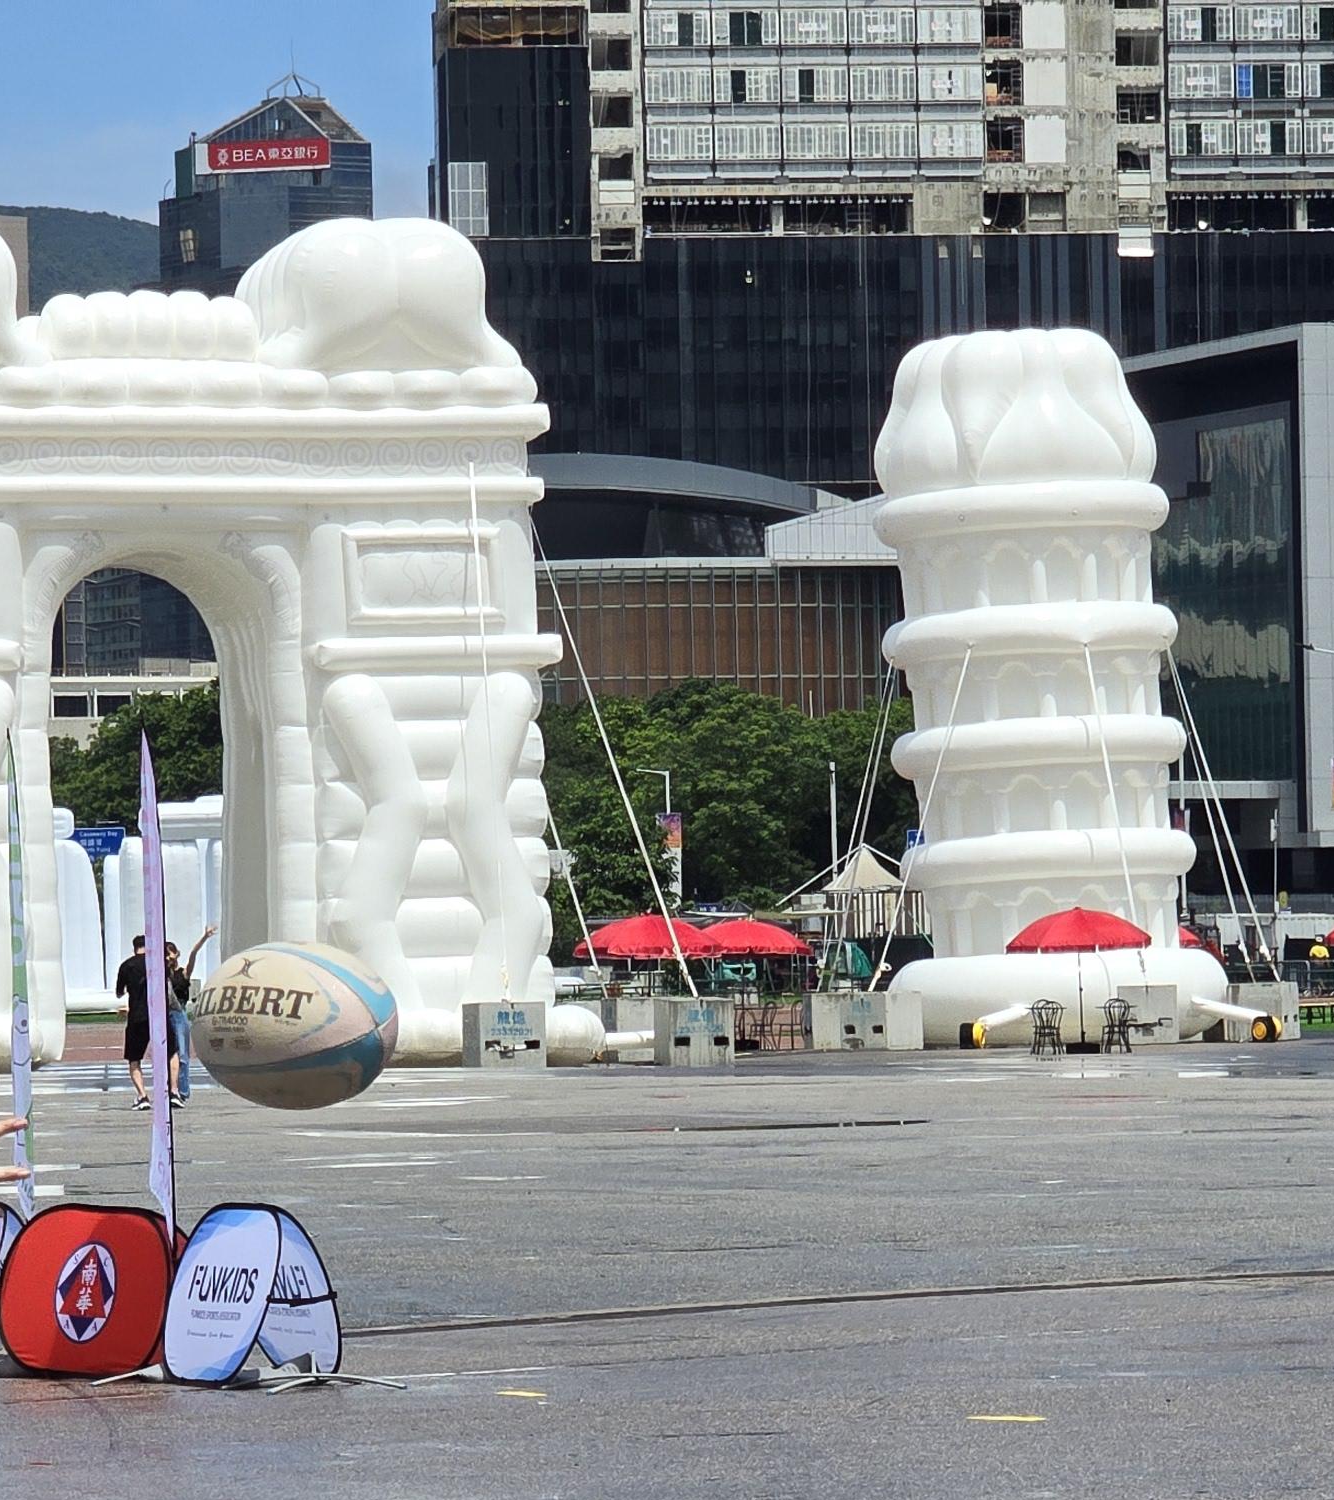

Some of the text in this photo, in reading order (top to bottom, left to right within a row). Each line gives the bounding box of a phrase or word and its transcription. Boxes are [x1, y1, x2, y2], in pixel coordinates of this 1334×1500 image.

[232, 145, 319, 162] BEA 東亞銀行
[195, 985, 314, 1020] ILBERT
[188, 1265, 259, 1305] FUNKIDS
